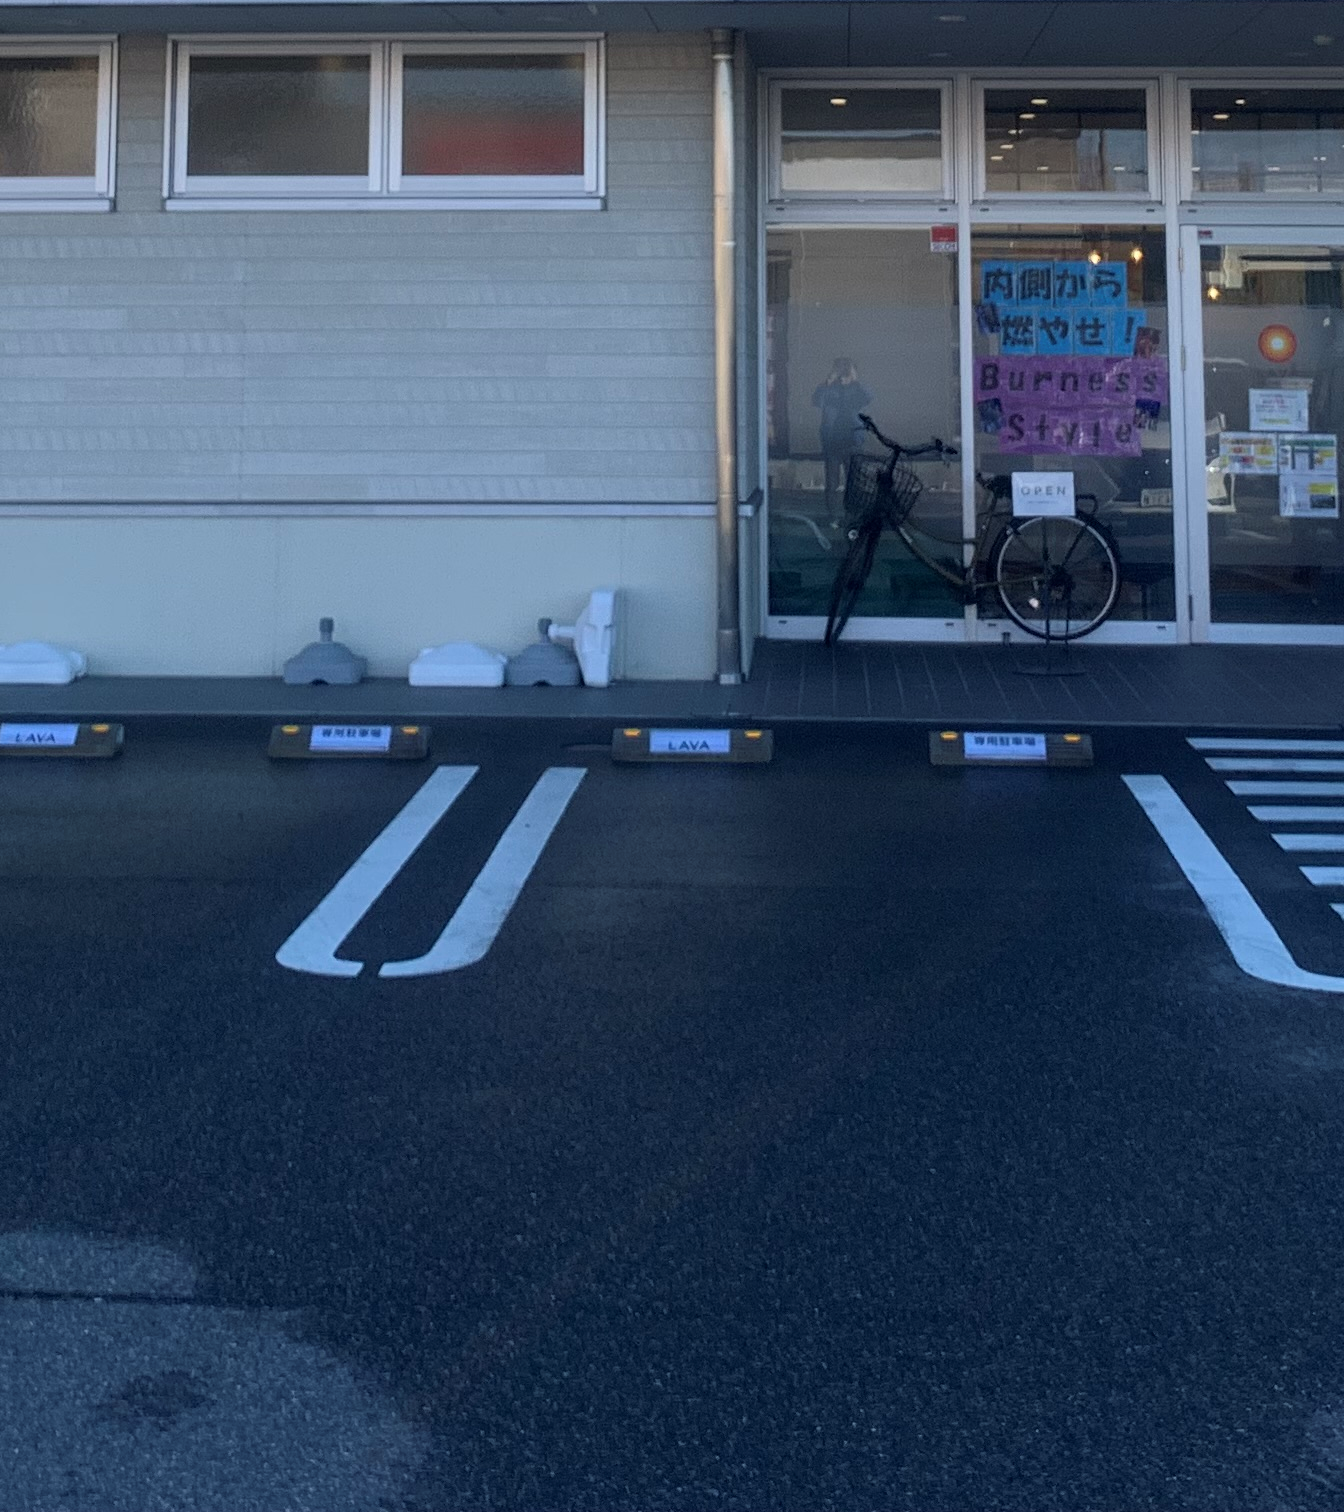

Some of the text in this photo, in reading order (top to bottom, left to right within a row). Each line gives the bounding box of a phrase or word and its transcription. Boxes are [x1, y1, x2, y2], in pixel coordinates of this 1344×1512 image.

[984, 268, 1122, 300] 内側から
[980, 362, 1158, 392] Burness
[1008, 412, 1133, 447] Style
[1020, 485, 1066, 496] OPEN
[15, 732, 56, 743] LAVA
[667, 739, 711, 751] LAVA
